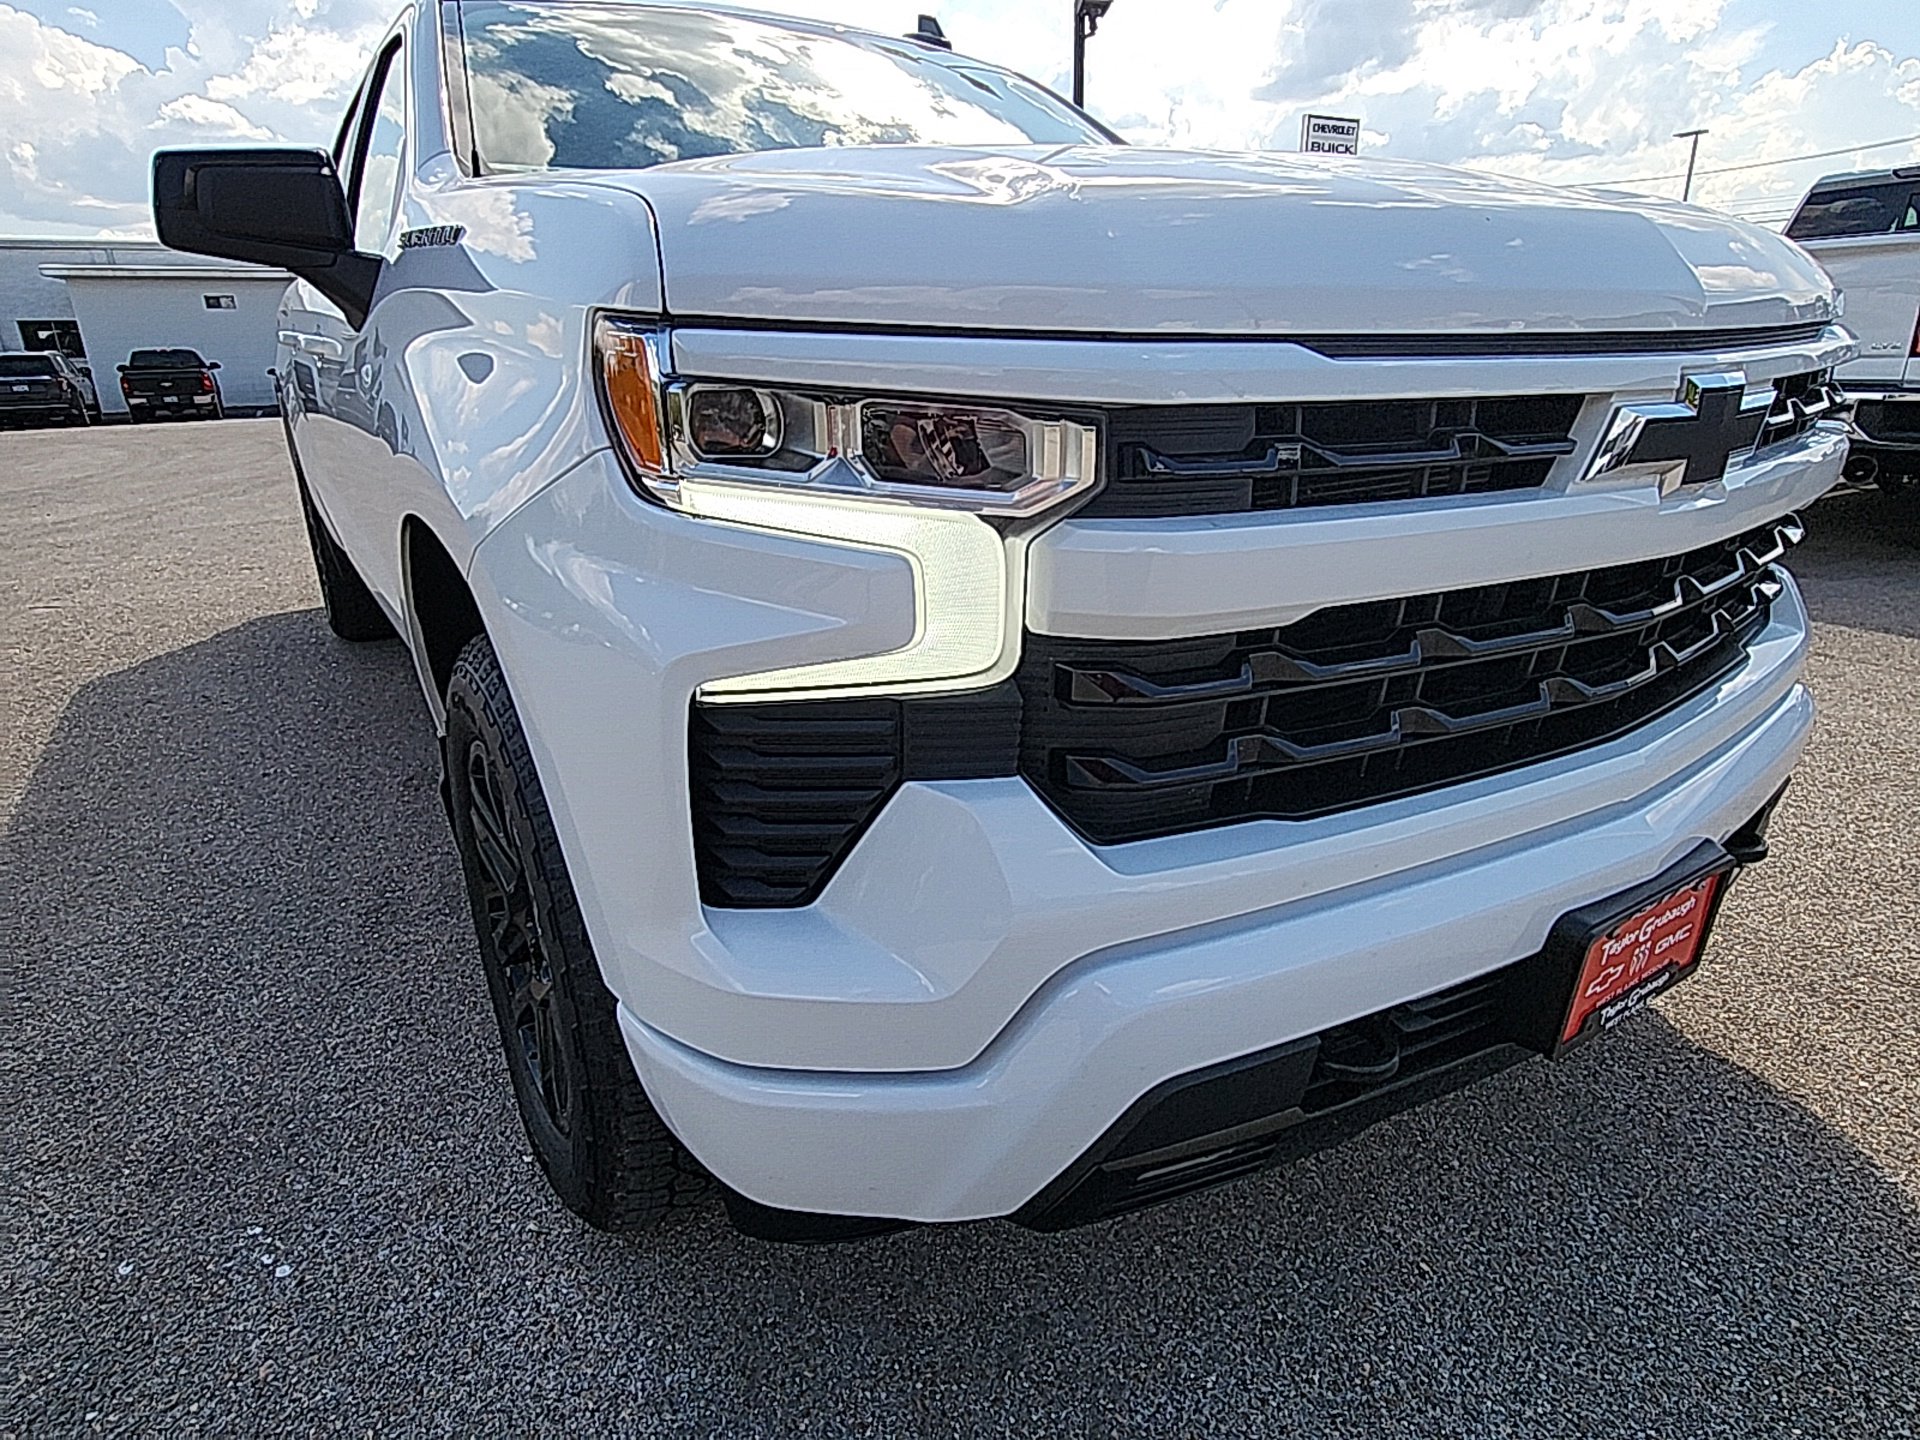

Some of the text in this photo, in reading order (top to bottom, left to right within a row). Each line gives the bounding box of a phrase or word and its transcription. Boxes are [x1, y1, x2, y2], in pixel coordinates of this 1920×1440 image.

[1312, 123, 1357, 136] CHEVROLET
[1310, 141, 1354, 155] BUICK
[1602, 930, 1639, 966] Taylor
[1655, 924, 1693, 954] GMC
